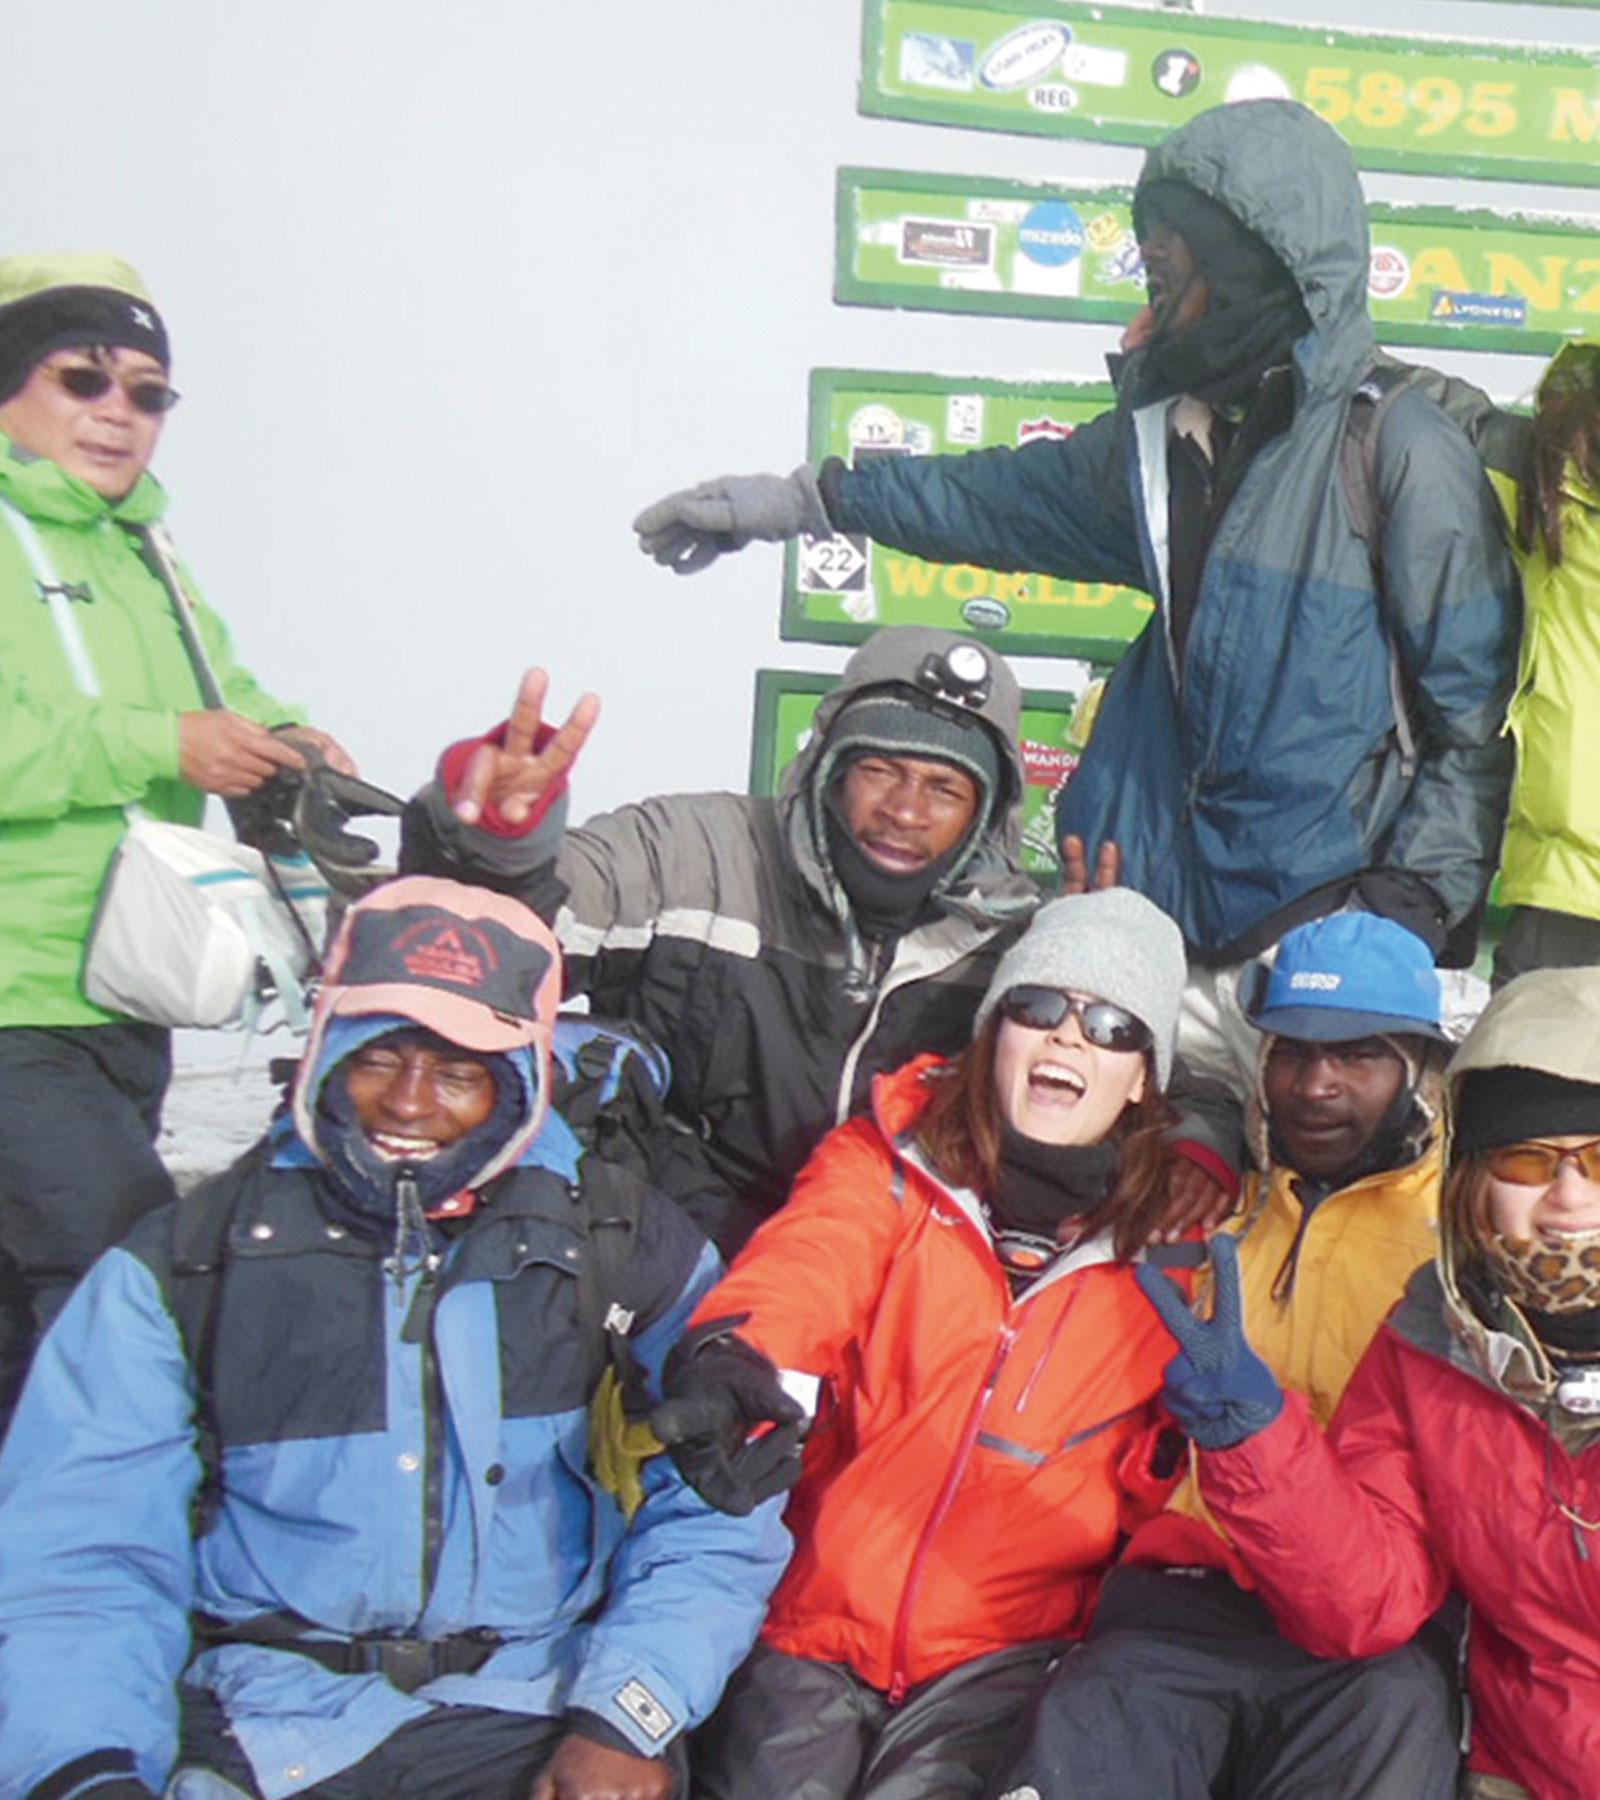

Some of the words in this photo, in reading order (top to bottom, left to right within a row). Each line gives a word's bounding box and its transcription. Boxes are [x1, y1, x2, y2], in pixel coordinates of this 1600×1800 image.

[1034, 89, 1071, 108] REG
[1304, 68, 1518, 137] 5895
[818, 549, 851, 573] 22
[886, 560, 1156, 608] WORLD
